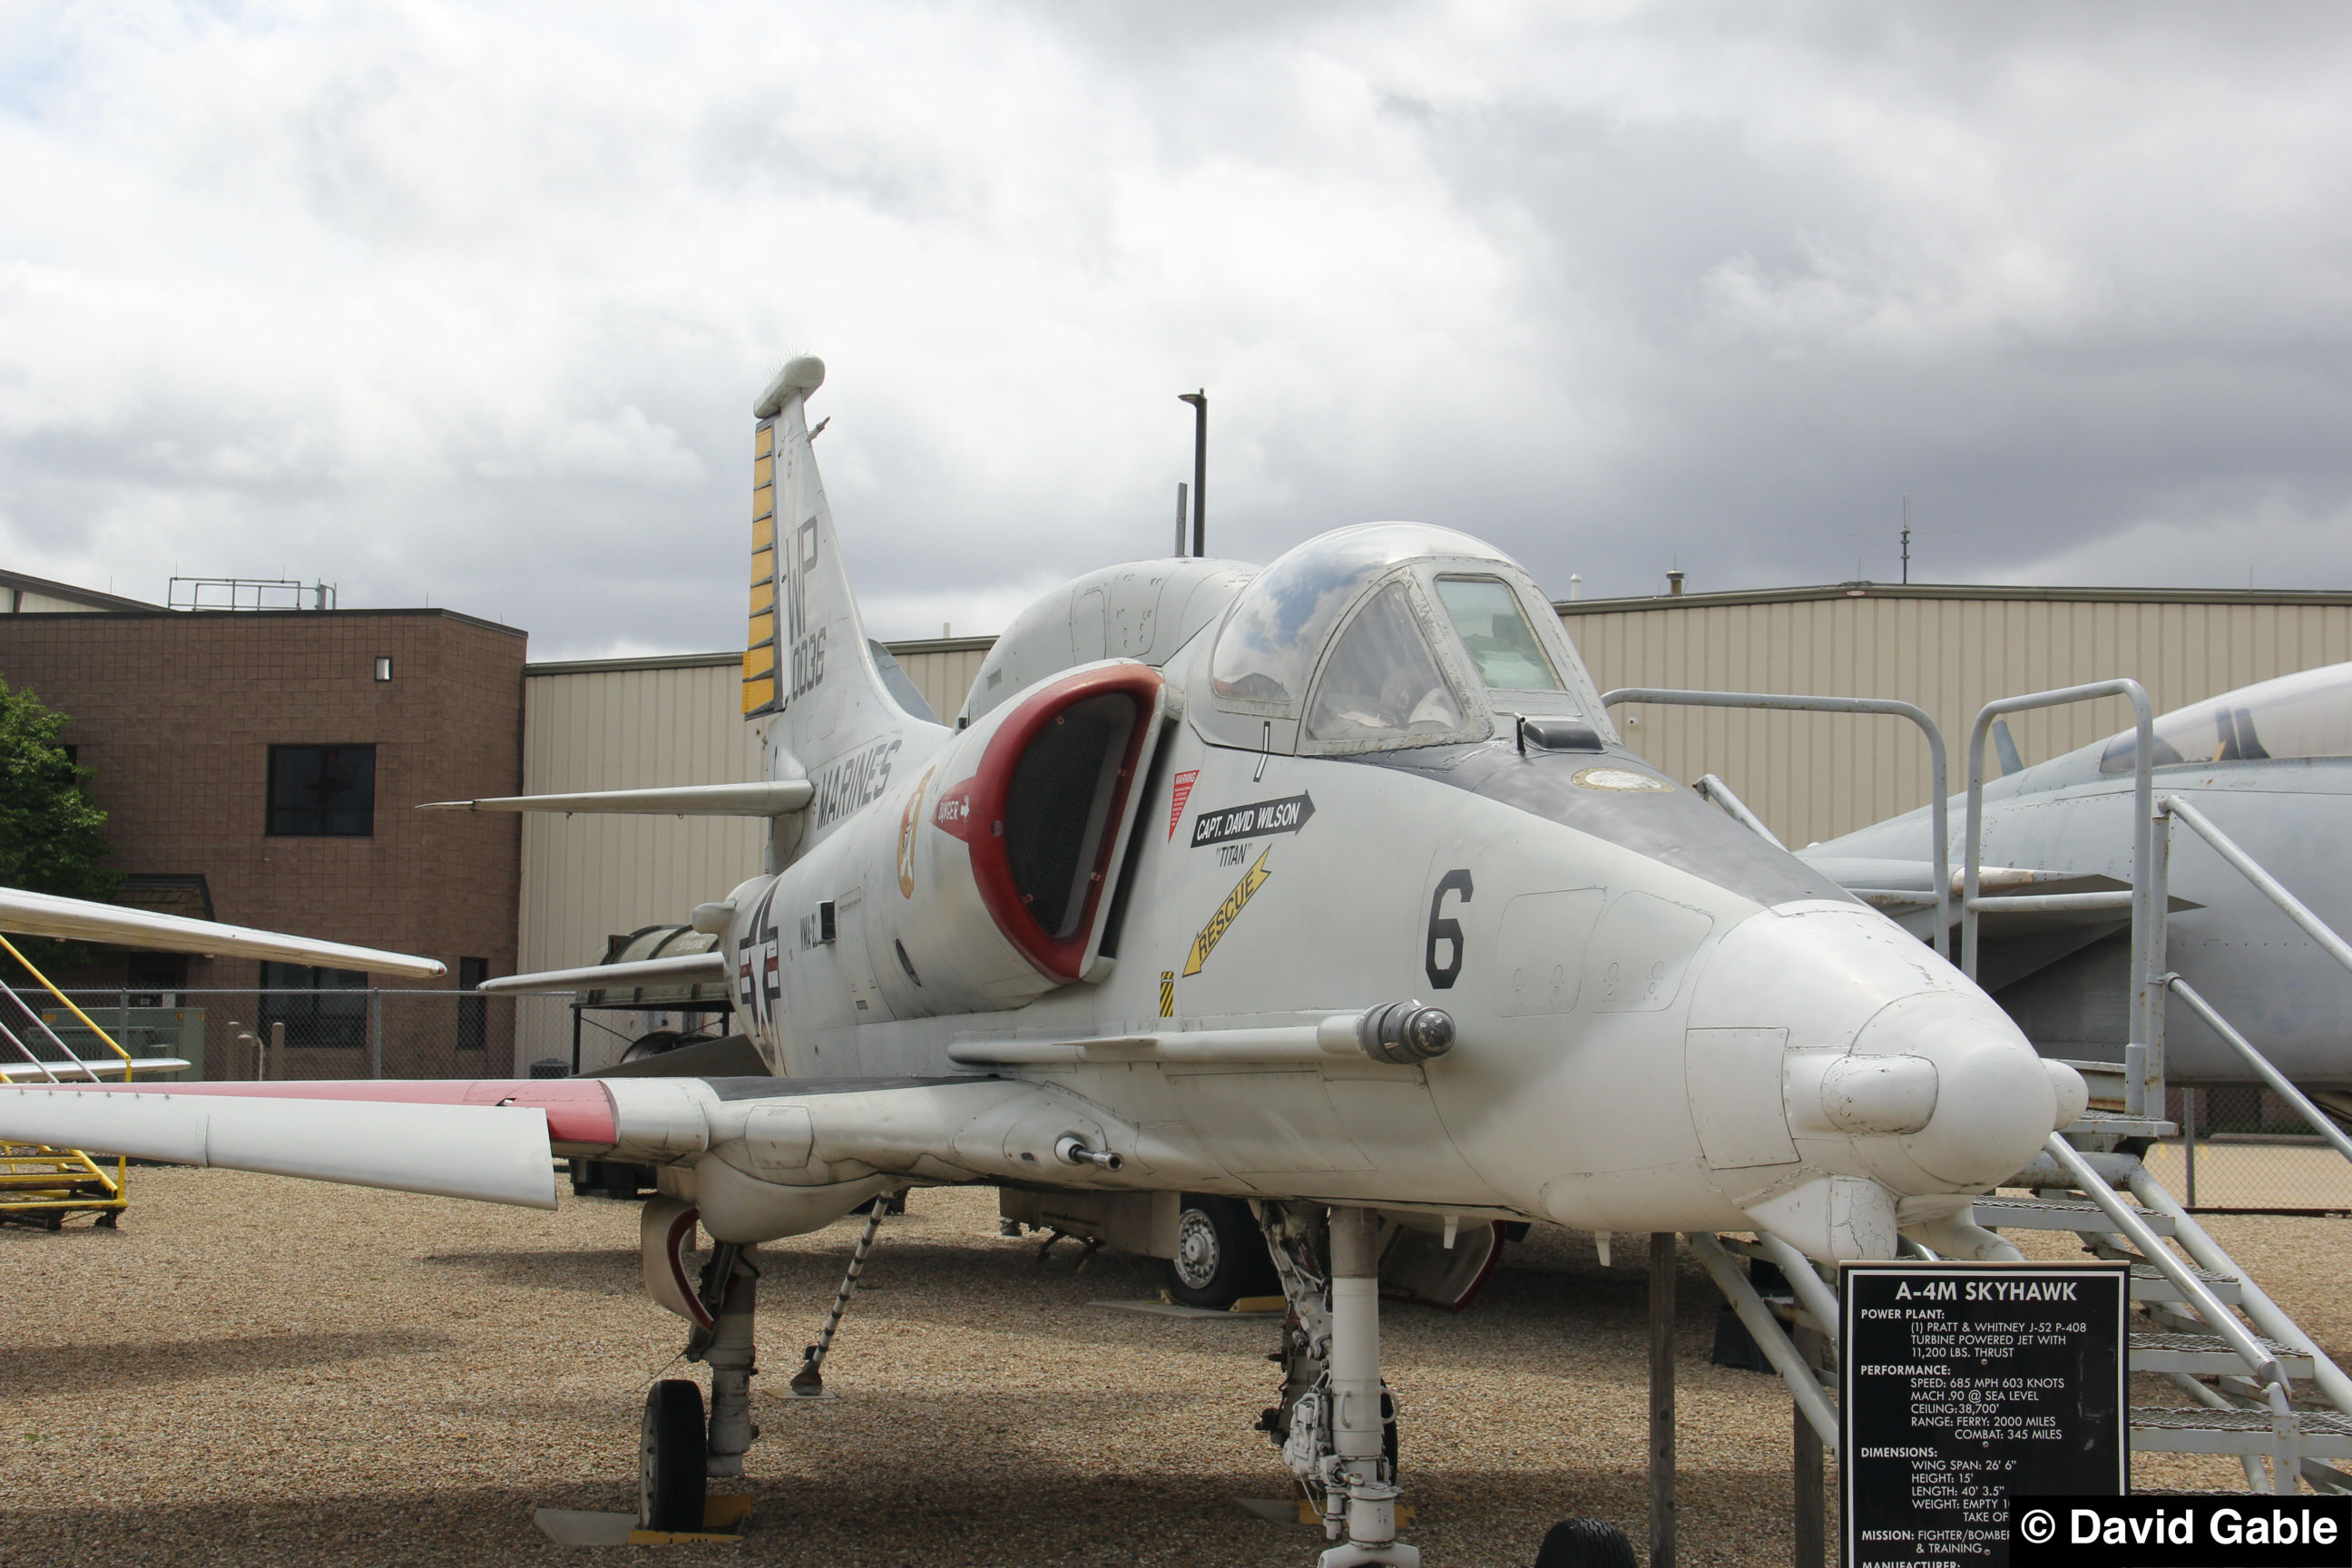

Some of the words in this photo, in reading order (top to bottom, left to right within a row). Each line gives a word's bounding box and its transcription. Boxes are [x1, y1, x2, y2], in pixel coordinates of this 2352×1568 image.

[786, 514, 818, 647] WP
[817, 739, 903, 831] MARINES
[1196, 814, 1222, 841] CAPT.
[1224, 808, 1256, 836] DAVID
[1257, 801, 1301, 830] WILSON
[1197, 869, 1256, 962] RESCUE
[1426, 869, 1474, 989] 6
[1895, 1280, 1957, 1301] A-4M
[1965, 1281, 2078, 1301] SKYHAWK
[1861, 1308, 1902, 1319] POWER
[1906, 1308, 1945, 1319] PLANT:
[1911, 1321, 1924, 1334] (1)
[1926, 1321, 1959, 1332] PRATT
[1961, 1321, 1971, 1333] &
[1974, 1322, 2026, 1333] WHITNEY
[2028, 1322, 2052, 1333] J-52
[2055, 1322, 2087, 1333] P-408
[1910, 1334, 1955, 1345] TURBINE
[1958, 1335, 2014, 1346] POWERED
[2016, 1335, 2034, 1346] JET
[2036, 1335, 2066, 1346] WITH
[1912, 1347, 1946, 1359] 11,200
[1950, 1347, 1971, 1358] LBS.
[1974, 1347, 2014, 1358] THRUST
[1860, 1365, 1951, 1376] PERFORMANCE:
[1910, 1377, 1946, 1388] SPEED:
[1949, 1377, 1971, 1388] 685
[1974, 1377, 1999, 1388] MPH
[2002, 1377, 2024, 1388] 603
[2026, 1377, 2065, 1388] KNOTS
[1910, 1390, 1945, 1401] MACH
[1947, 1390, 1965, 1401] .90
[1967, 1389, 1982, 1404] @
[1984, 1390, 2006, 1401] SEA
[2009, 1390, 2040, 1401] LEVEL
[1911, 1416, 1954, 1427] RANGE:
[1956, 1416, 1990, 1427] FERRY:
[1994, 1416, 2023, 1427] 2000
[2025, 1416, 2056, 1427] MILES
[1955, 1428, 2004, 1440] COMBAT:
[2007, 1428, 2028, 1440] 345
[2031, 1428, 2063, 1440] MILES
[1860, 1446, 1938, 1458] DIMENSIONS:
[1911, 1459, 1946, 1471] WING
[1949, 1459, 1982, 1471] SPAN:
[1985, 1459, 2002, 1471] 26'
[2004, 1459, 2017, 1471] 6"
[1911, 1473, 1955, 1484] HEIGHT:
[1958, 1473, 1974, 1484] 15'
[1911, 1485, 1958, 1496] LENGTH:
[1961, 1485, 1979, 1496] 40'
[1982, 1485, 2004, 1496] 3.5"
[1911, 1498, 1960, 1509] WEIGHT:
[1963, 1498, 1998, 1509] EMPTY
[1962, 1511, 1989, 1523] TAKE
[1992, 1511, 2009, 1523] OF
[1861, 1530, 1915, 1541] MISSION:
[1916, 1543, 1925, 1553] &
[1928, 1543, 1983, 1553] TRAINING
